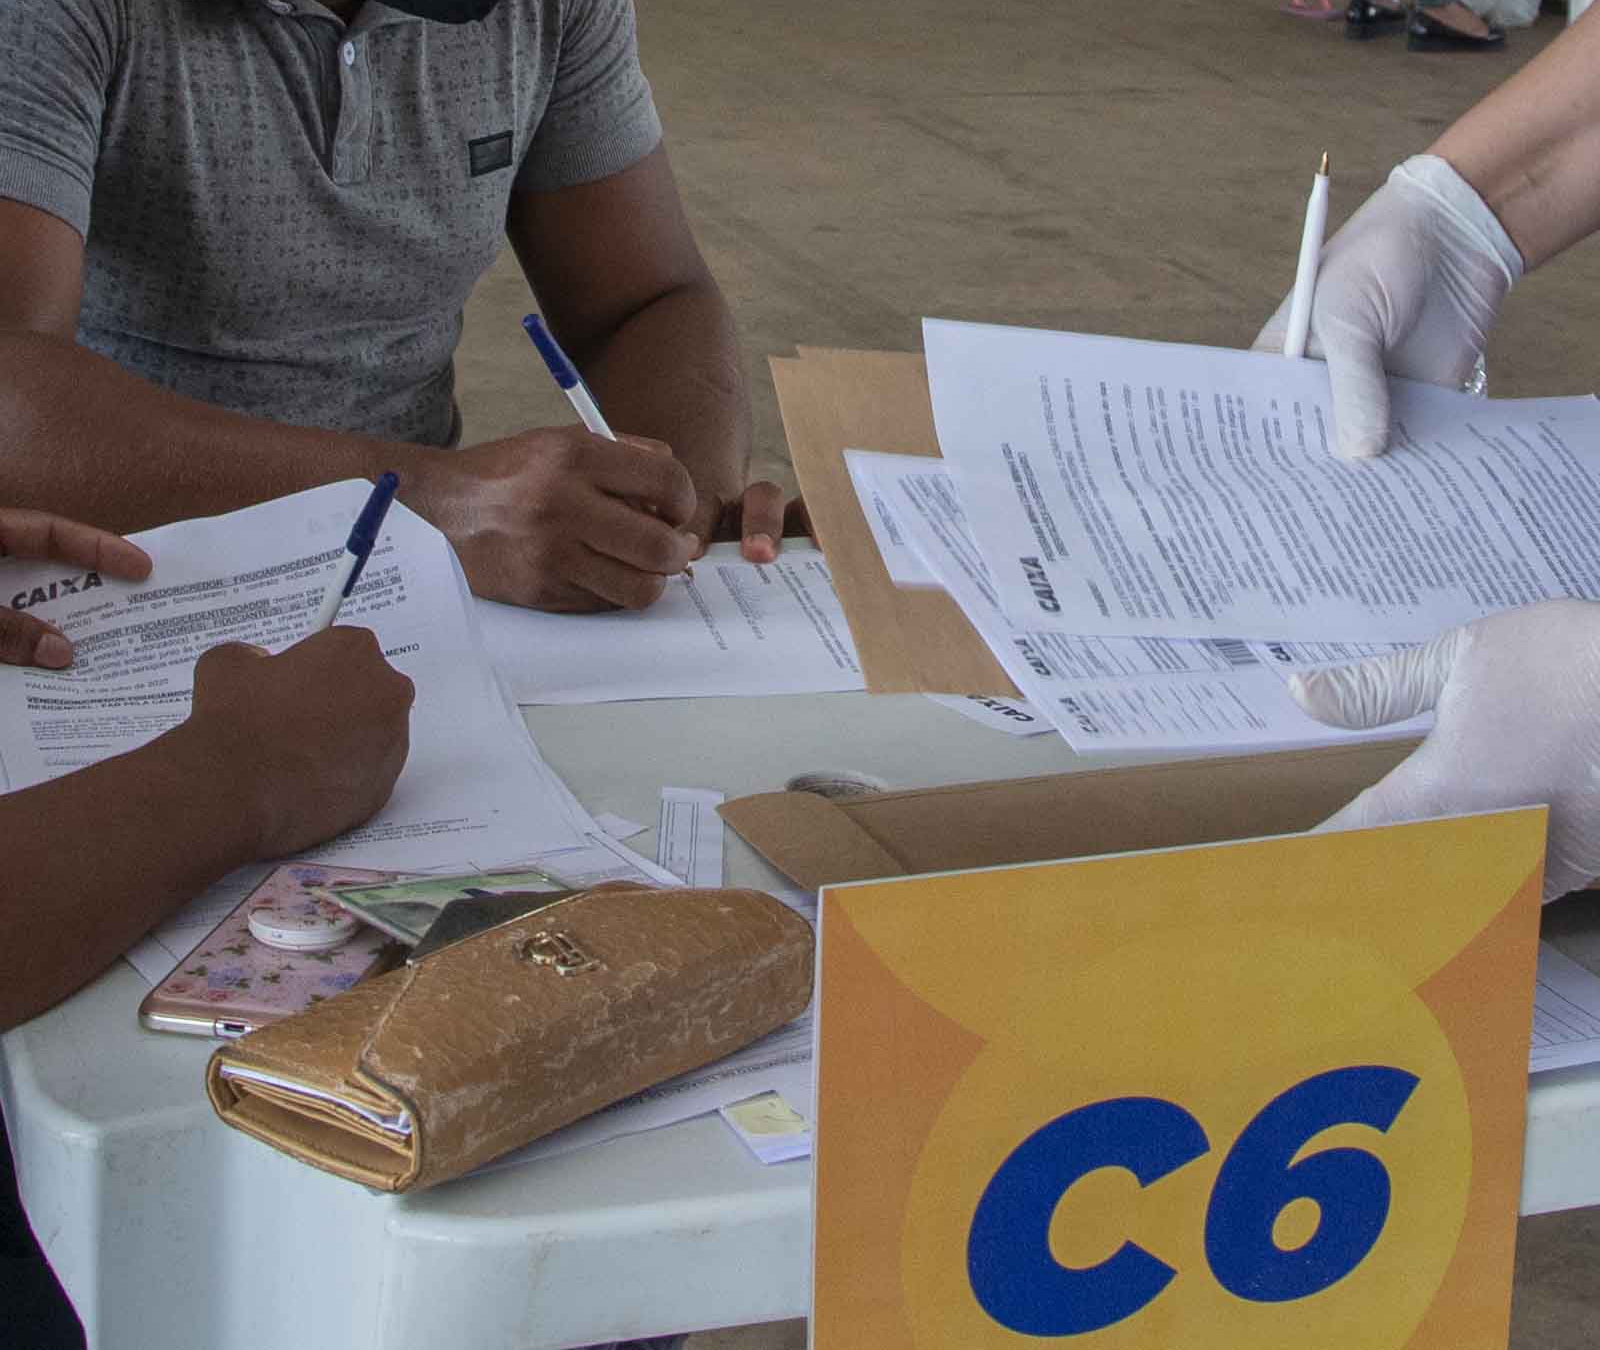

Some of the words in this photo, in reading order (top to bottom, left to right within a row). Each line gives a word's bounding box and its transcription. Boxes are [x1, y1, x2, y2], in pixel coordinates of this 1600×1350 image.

[11, 573, 102, 610] CAIXA
[1019, 557, 1061, 612] CAIXA
[965, 1064, 1421, 1338] C6
